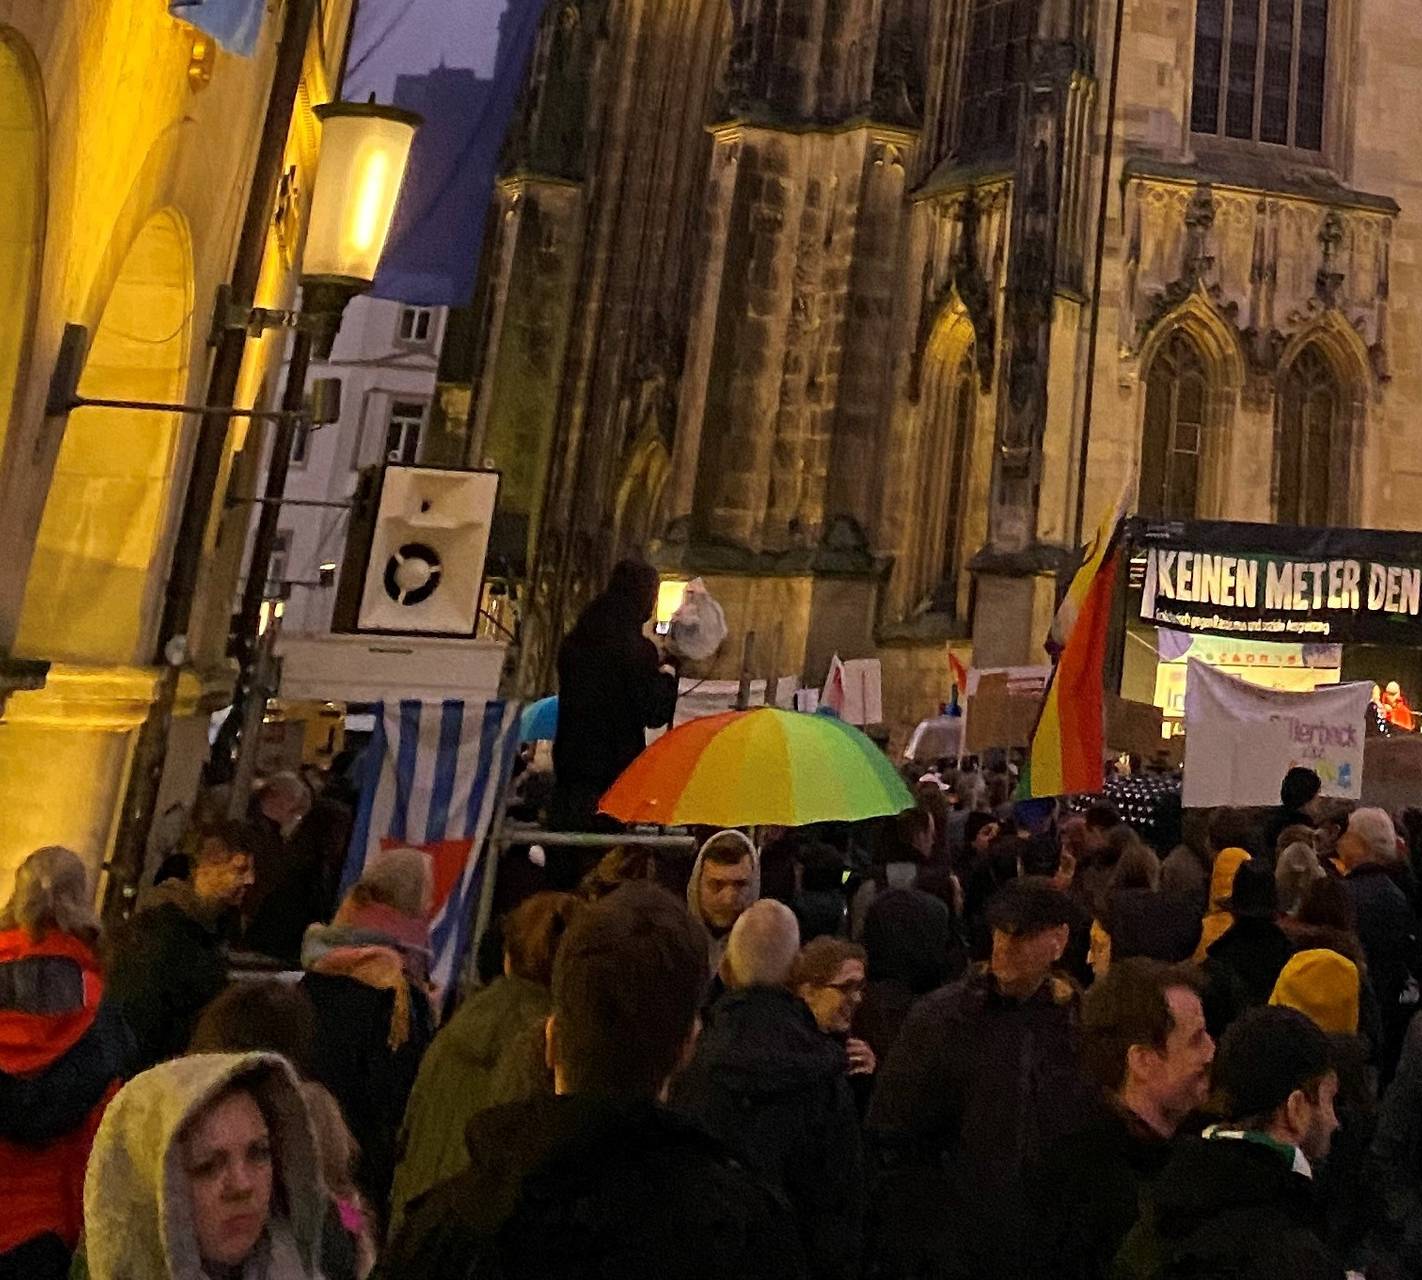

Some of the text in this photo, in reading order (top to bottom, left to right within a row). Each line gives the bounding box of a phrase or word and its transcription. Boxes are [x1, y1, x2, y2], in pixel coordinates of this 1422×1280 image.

[1156, 549, 1258, 608] KEINEN
[1265, 558, 1361, 611] METER
[1367, 562, 1421, 616] DEN
